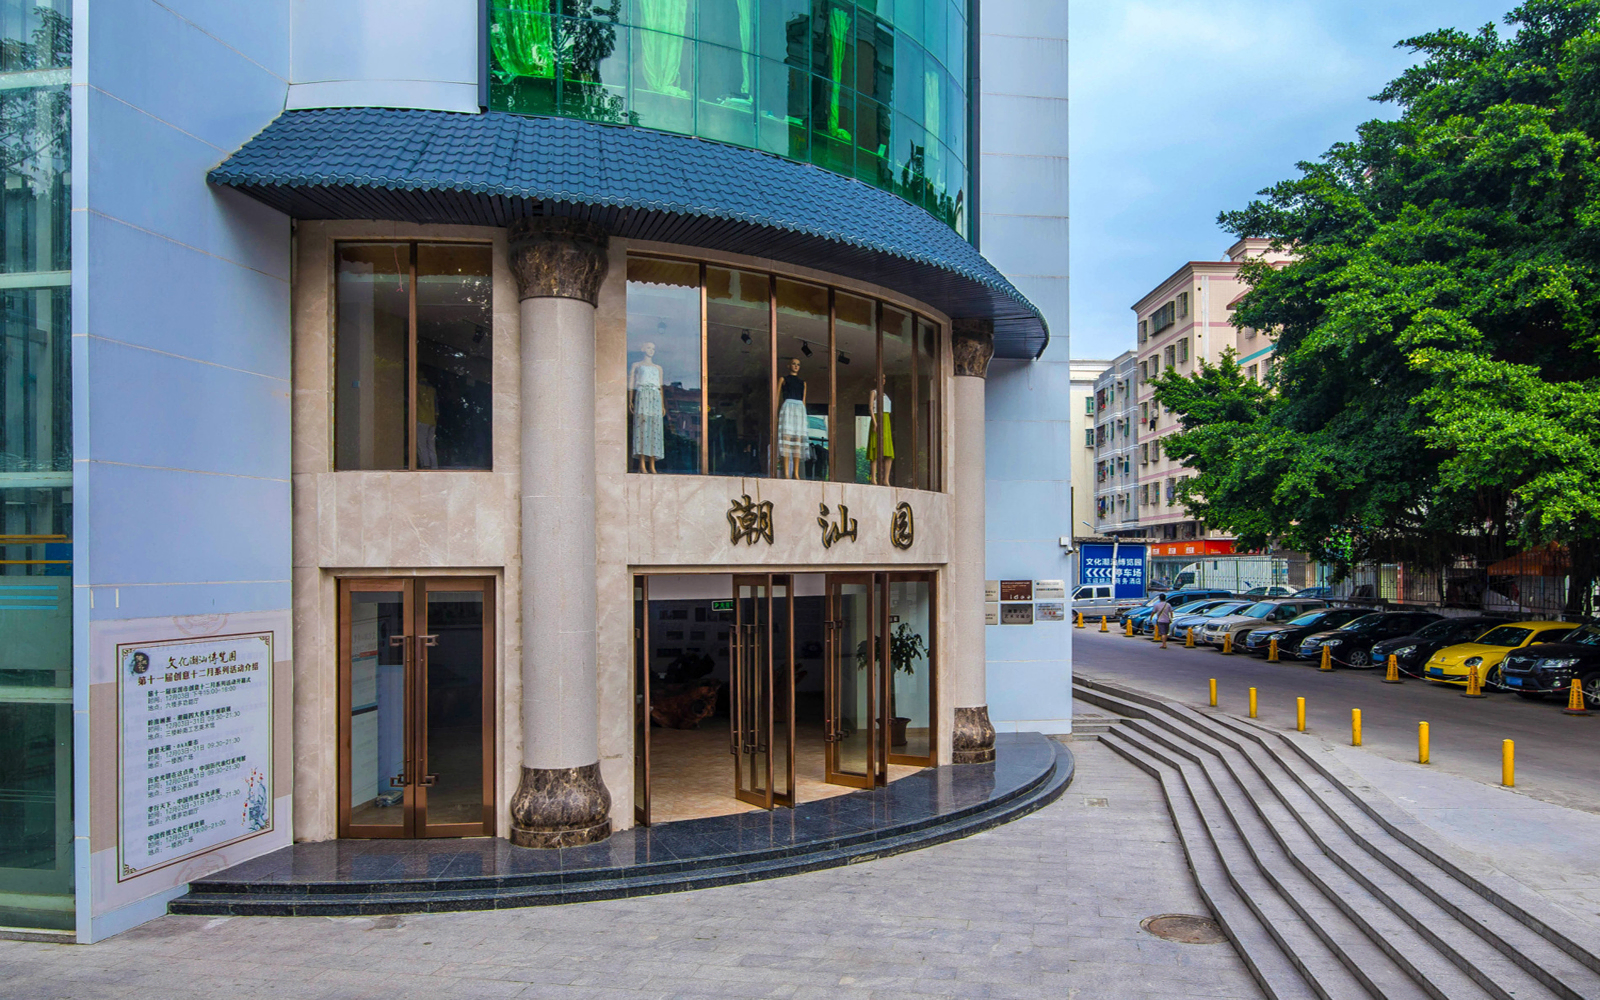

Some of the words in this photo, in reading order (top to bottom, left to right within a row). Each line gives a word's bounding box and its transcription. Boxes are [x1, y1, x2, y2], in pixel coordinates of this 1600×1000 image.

[1115, 568, 1142, 577] 停车场
[138, 662, 258, 686] 第十一届创意十二月系列活动介绍
